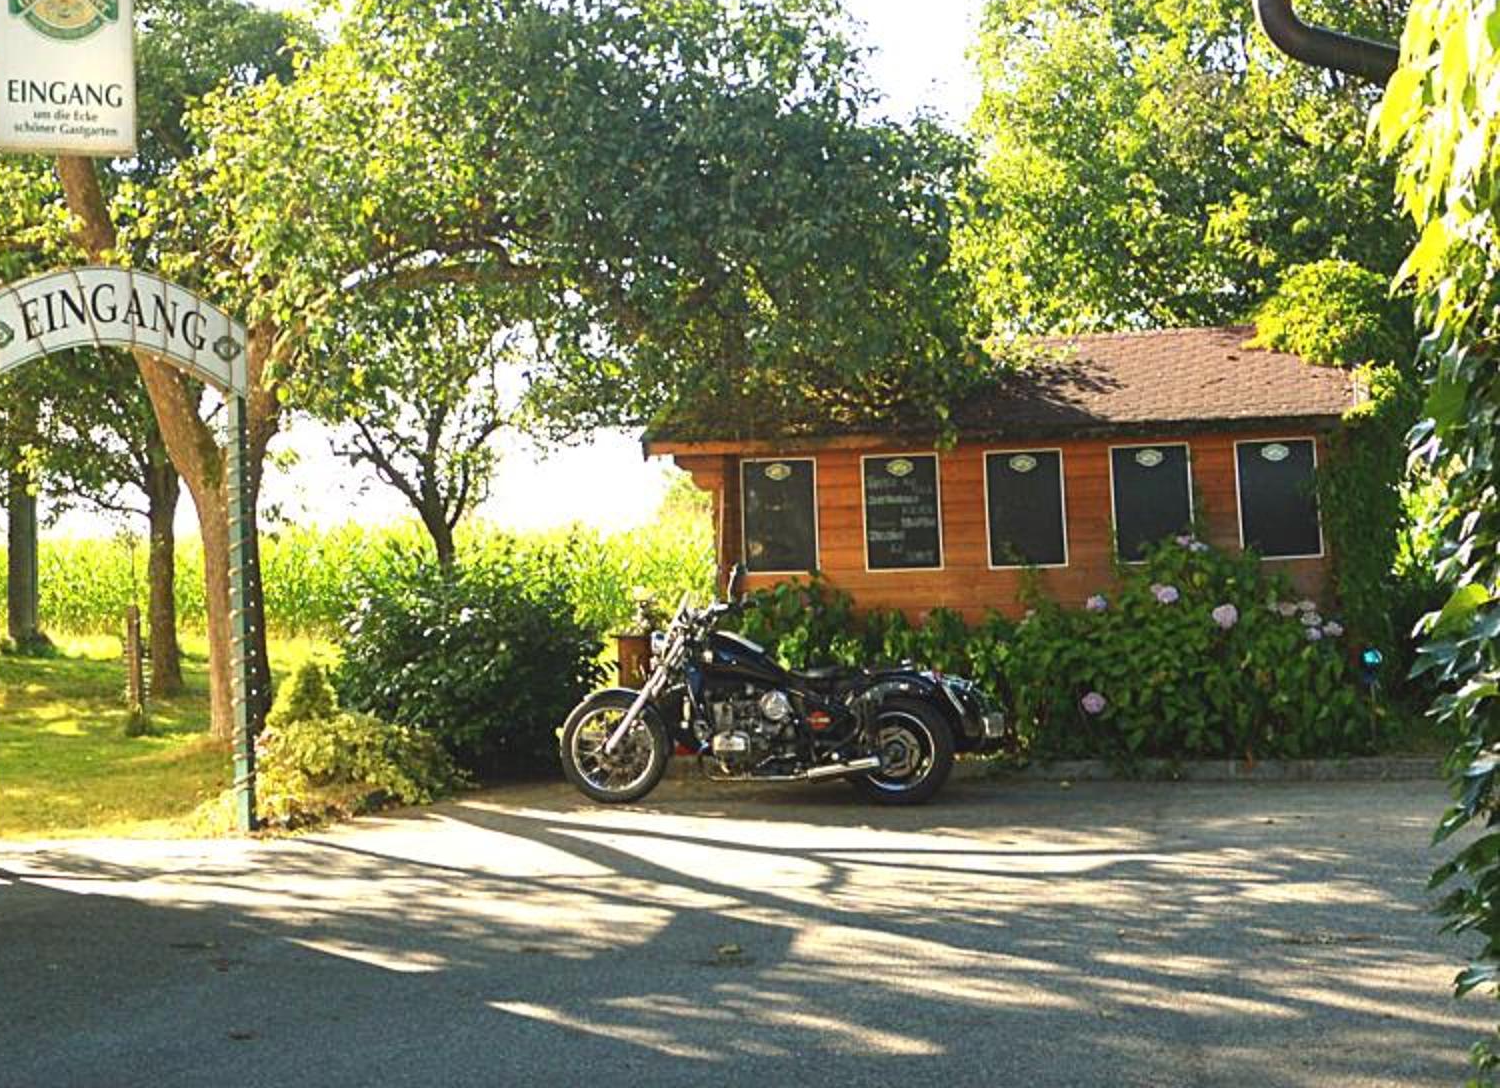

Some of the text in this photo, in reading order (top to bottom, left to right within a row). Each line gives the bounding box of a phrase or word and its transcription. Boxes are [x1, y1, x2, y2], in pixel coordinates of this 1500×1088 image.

[7, 79, 123, 109] EINGANG
[53, 109, 71, 121] die
[73, 110, 98, 122] Ecke
[13, 120, 56, 134] schöner
[21, 282, 208, 352] EINGANG
